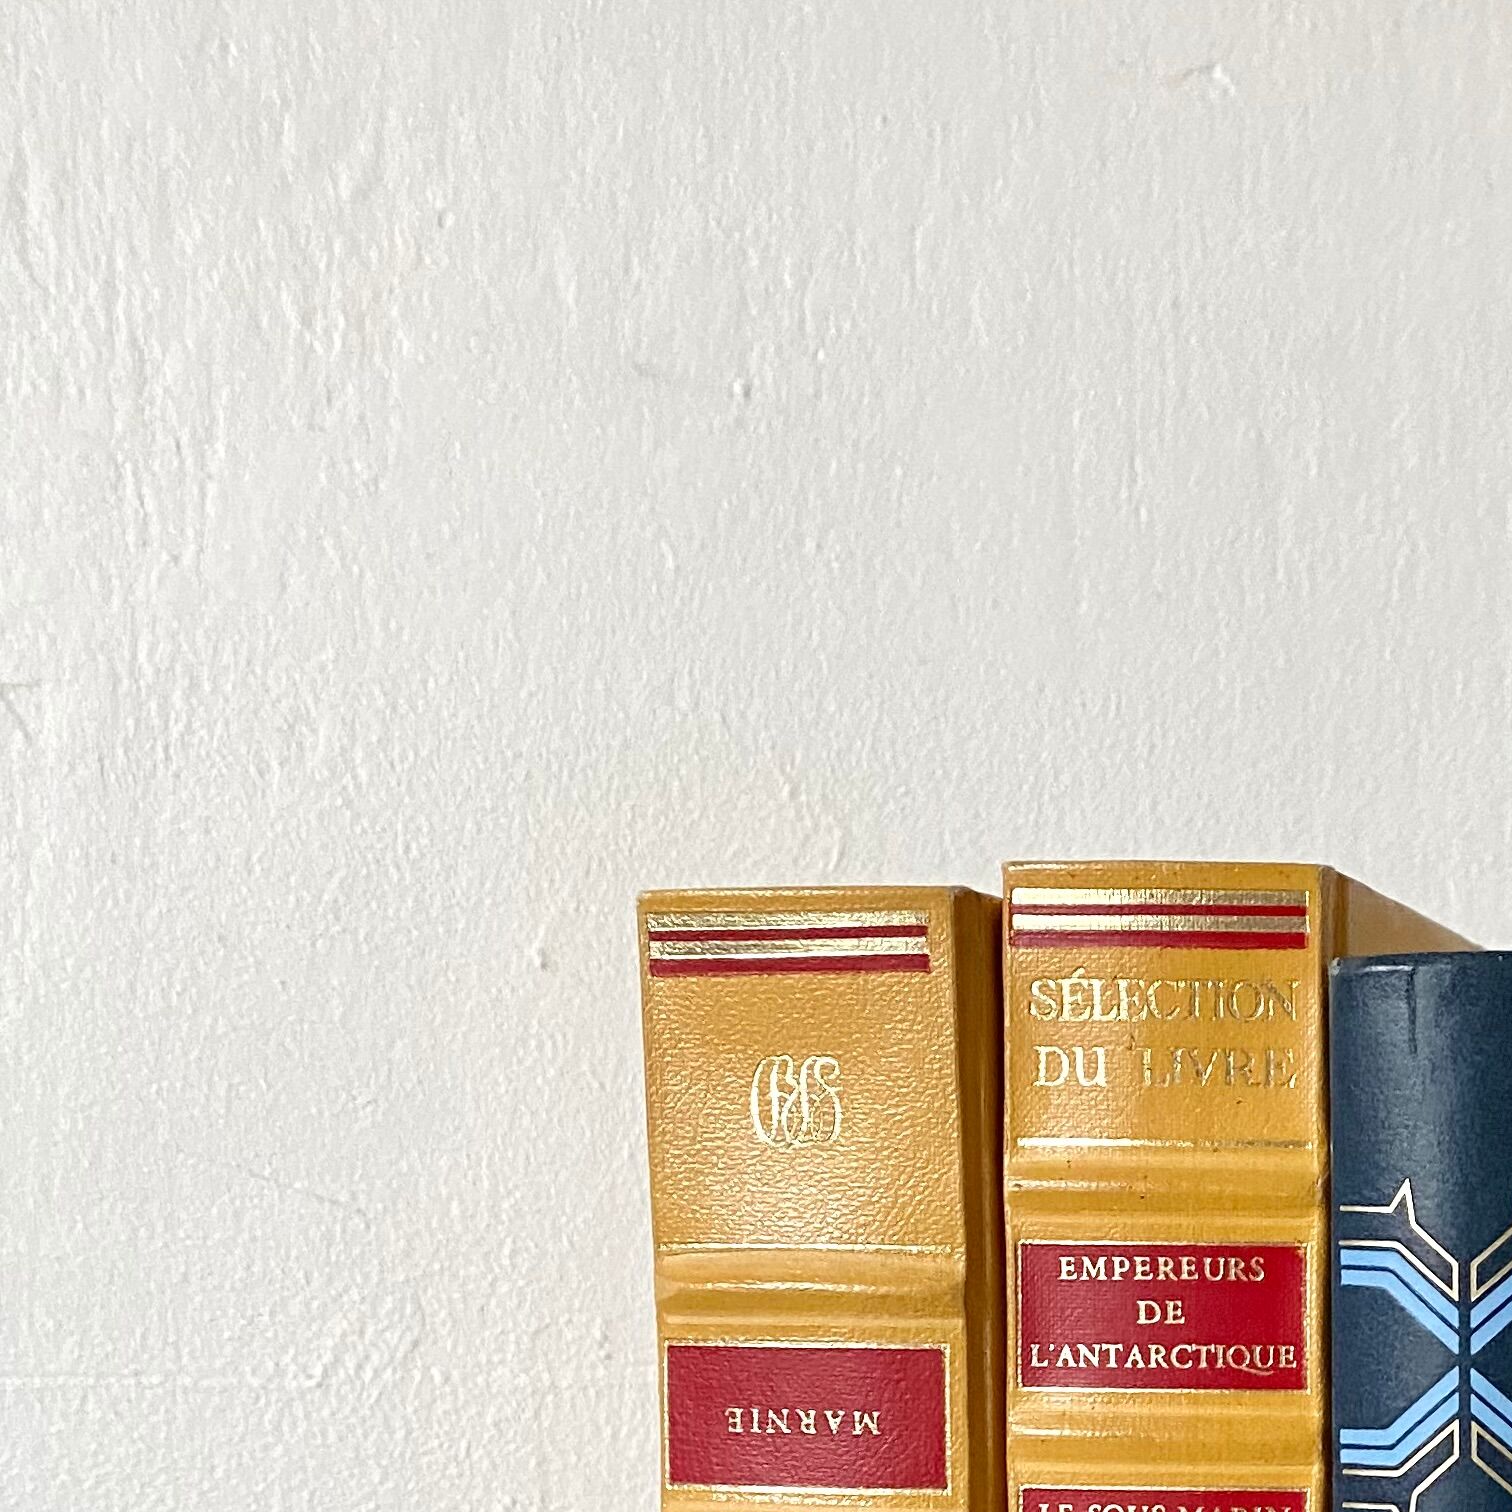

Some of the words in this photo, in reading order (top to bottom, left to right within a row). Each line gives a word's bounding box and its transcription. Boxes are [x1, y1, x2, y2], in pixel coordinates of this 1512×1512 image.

[1030, 969, 1300, 1023] SÉLECTION
[1033, 1045, 1106, 1087] DU
[1139, 1045, 1299, 1088] LIVRE
[1058, 1256, 1265, 1281] EMPEREURS
[1136, 1300, 1186, 1324] DE
[1031, 1342, 1297, 1377] L'ANTARCTIQUE
[724, 1406, 882, 1437] MARNIE
